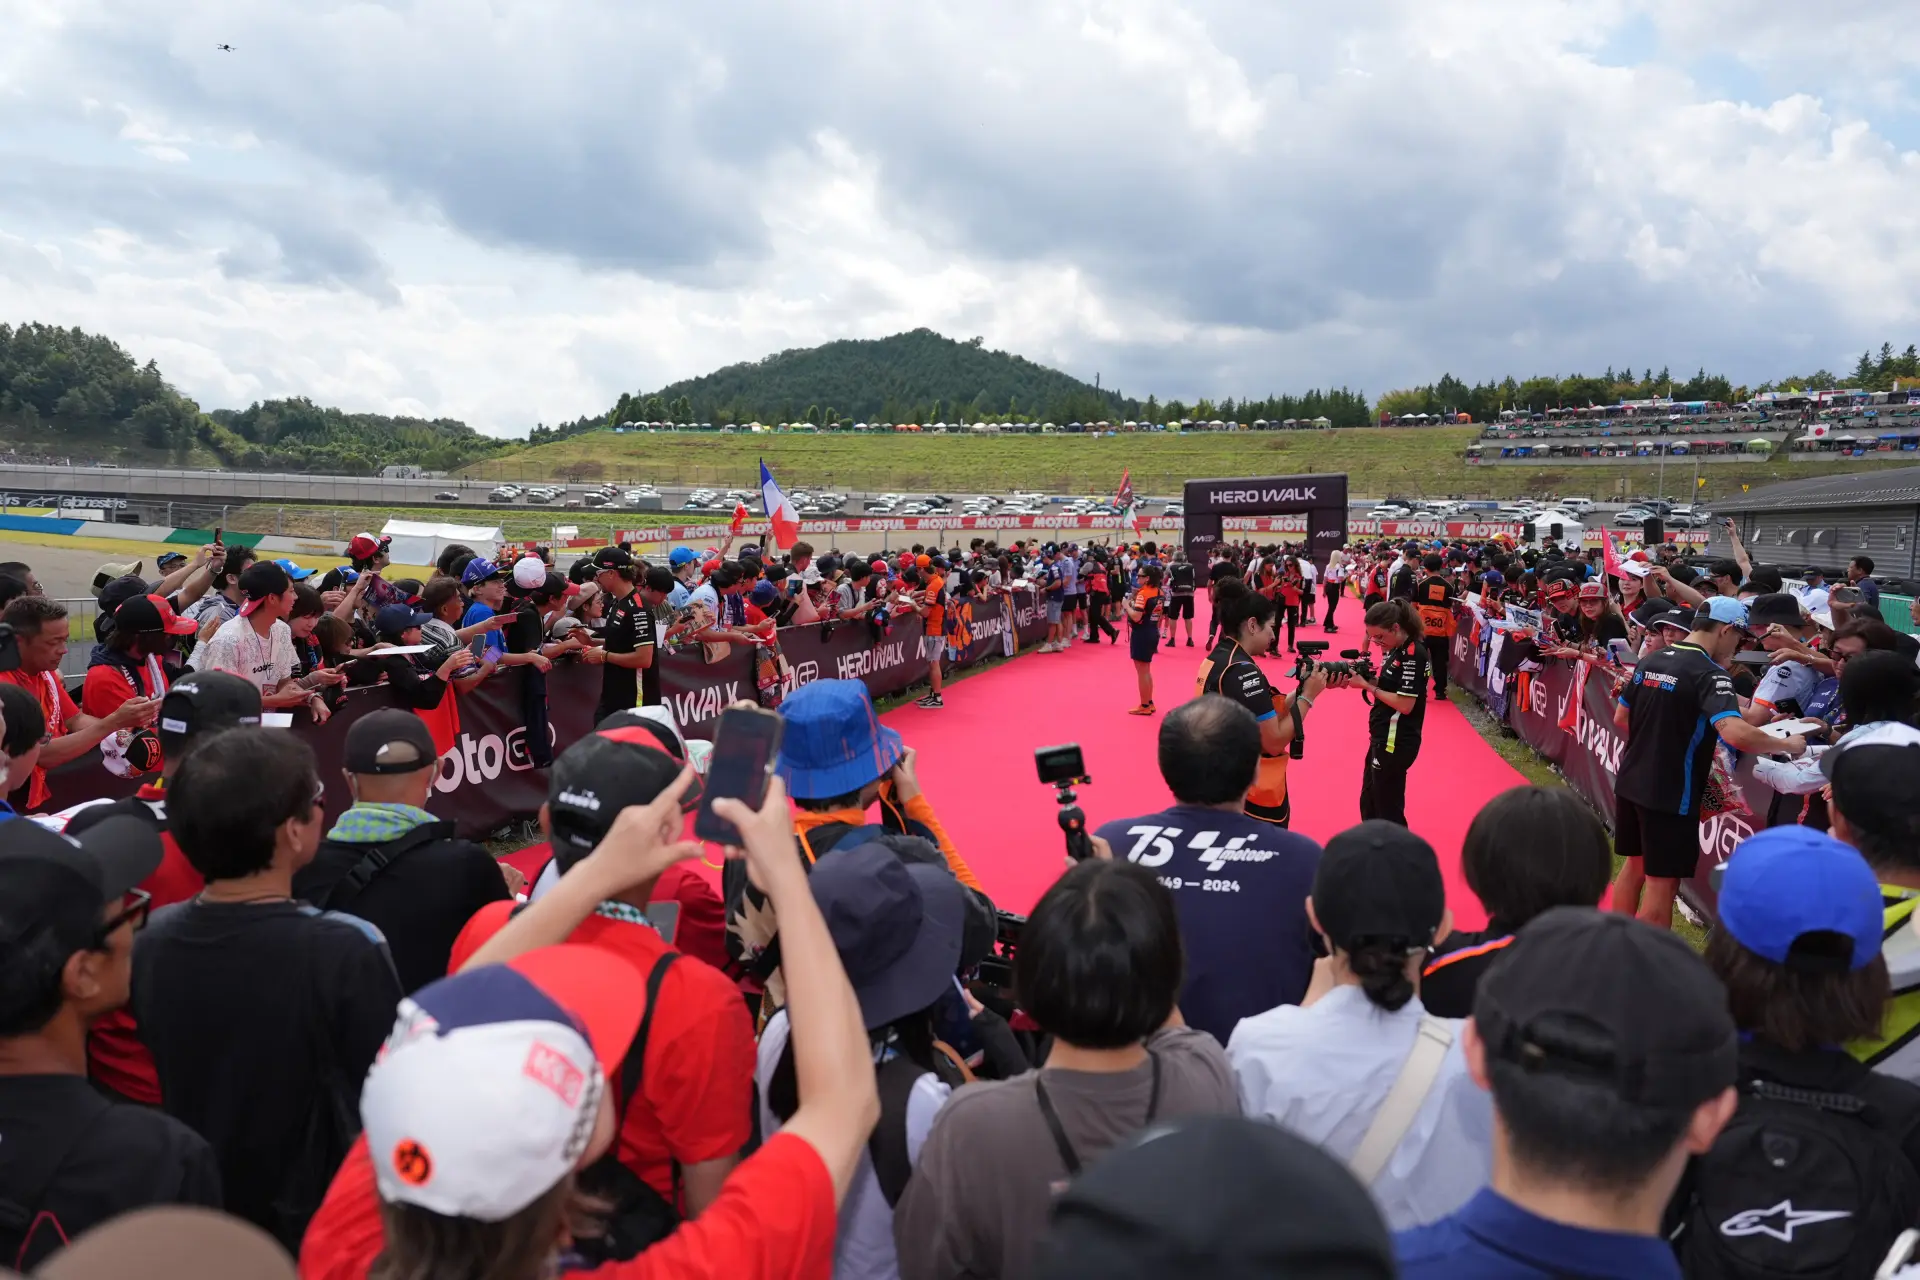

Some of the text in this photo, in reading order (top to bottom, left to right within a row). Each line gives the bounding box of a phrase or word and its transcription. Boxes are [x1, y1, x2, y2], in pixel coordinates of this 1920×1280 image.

[1210, 486, 1317, 504] HERO WALK
[801, 520, 848, 532] MOTUL
[859, 519, 906, 530] MOTUL
[917, 518, 963, 529] MOTUL
[975, 517, 1022, 529] MOTUL
[1032, 517, 1080, 528] MOTUL
[1222, 518, 1258, 530] OTUL
[1348, 520, 1383, 533] OTUL
[1396, 522, 1448, 535] MOTUL
[682, 525, 731, 539] MOTUL
[1461, 523, 1517, 537] MOTUL
[1425, 616, 1443, 628] 260
[837, 650, 871, 680] HERO
[873, 641, 905, 672] WALK
[1127, 825, 1183, 867] 75
[1203, 878, 1241, 892] 2024
